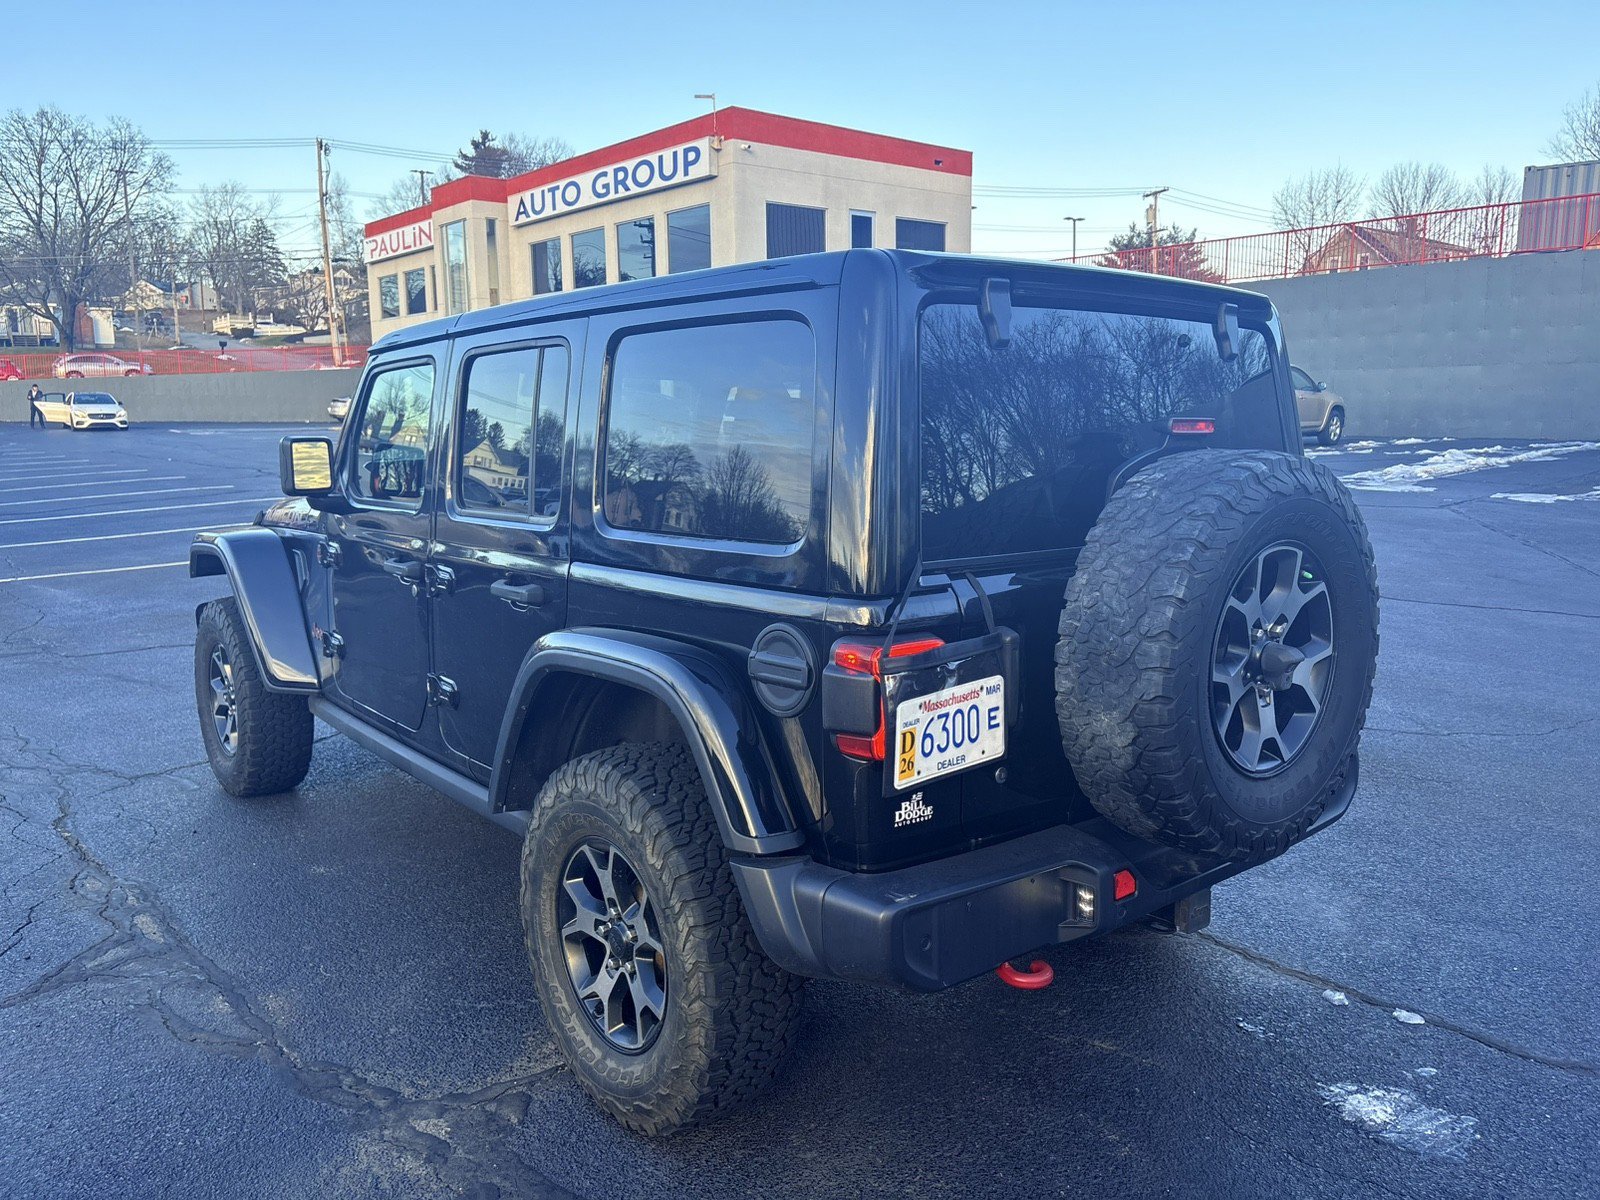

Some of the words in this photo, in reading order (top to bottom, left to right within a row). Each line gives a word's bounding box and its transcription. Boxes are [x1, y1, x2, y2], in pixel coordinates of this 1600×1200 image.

[514, 180, 581, 222] AUTO
[591, 145, 701, 199] GROUP
[985, 683, 1001, 696] MAR
[922, 689, 980, 713] Massachusetts
[902, 718, 920, 728] DEALER
[921, 704, 980, 758] 6300
[987, 705, 1000, 730] E
[901, 730, 915, 755] D
[900, 754, 915, 774] 26
[937, 754, 966, 771] DEALER
[894, 805, 934, 822] DODGE
[901, 800, 926, 813] BILL
